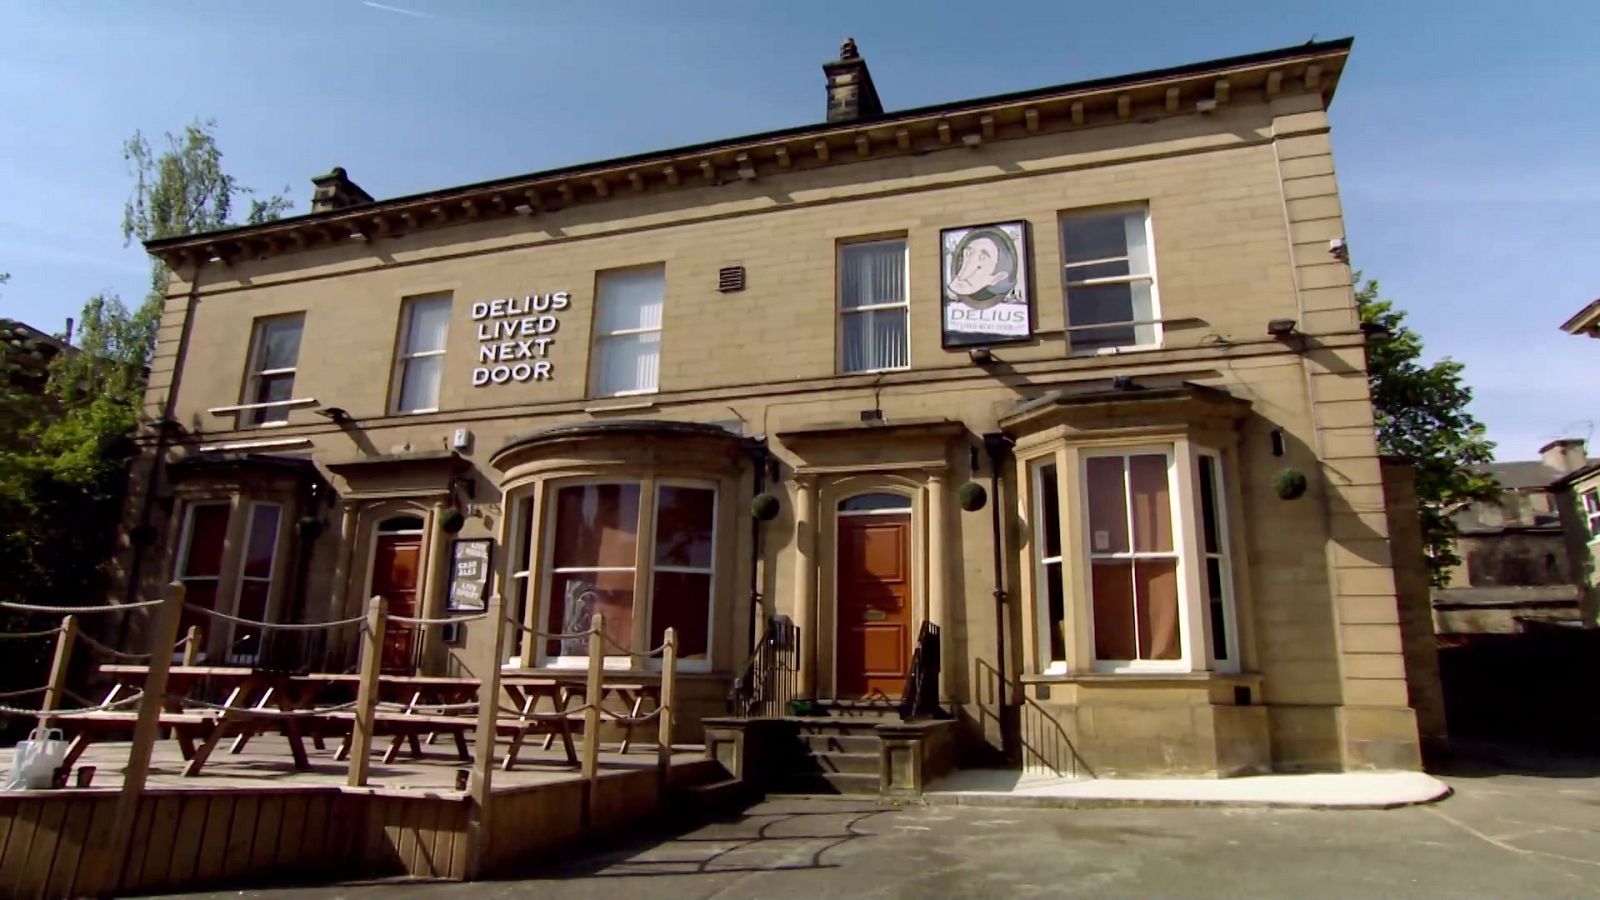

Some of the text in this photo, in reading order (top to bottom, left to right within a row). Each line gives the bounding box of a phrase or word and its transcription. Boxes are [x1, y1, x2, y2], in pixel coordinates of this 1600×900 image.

[472, 291, 568, 319] DELIUS
[951, 309, 1025, 322] DELIUS
[478, 315, 557, 340] LIVED
[480, 338, 552, 362] NEXT
[472, 361, 552, 386] DOOR
